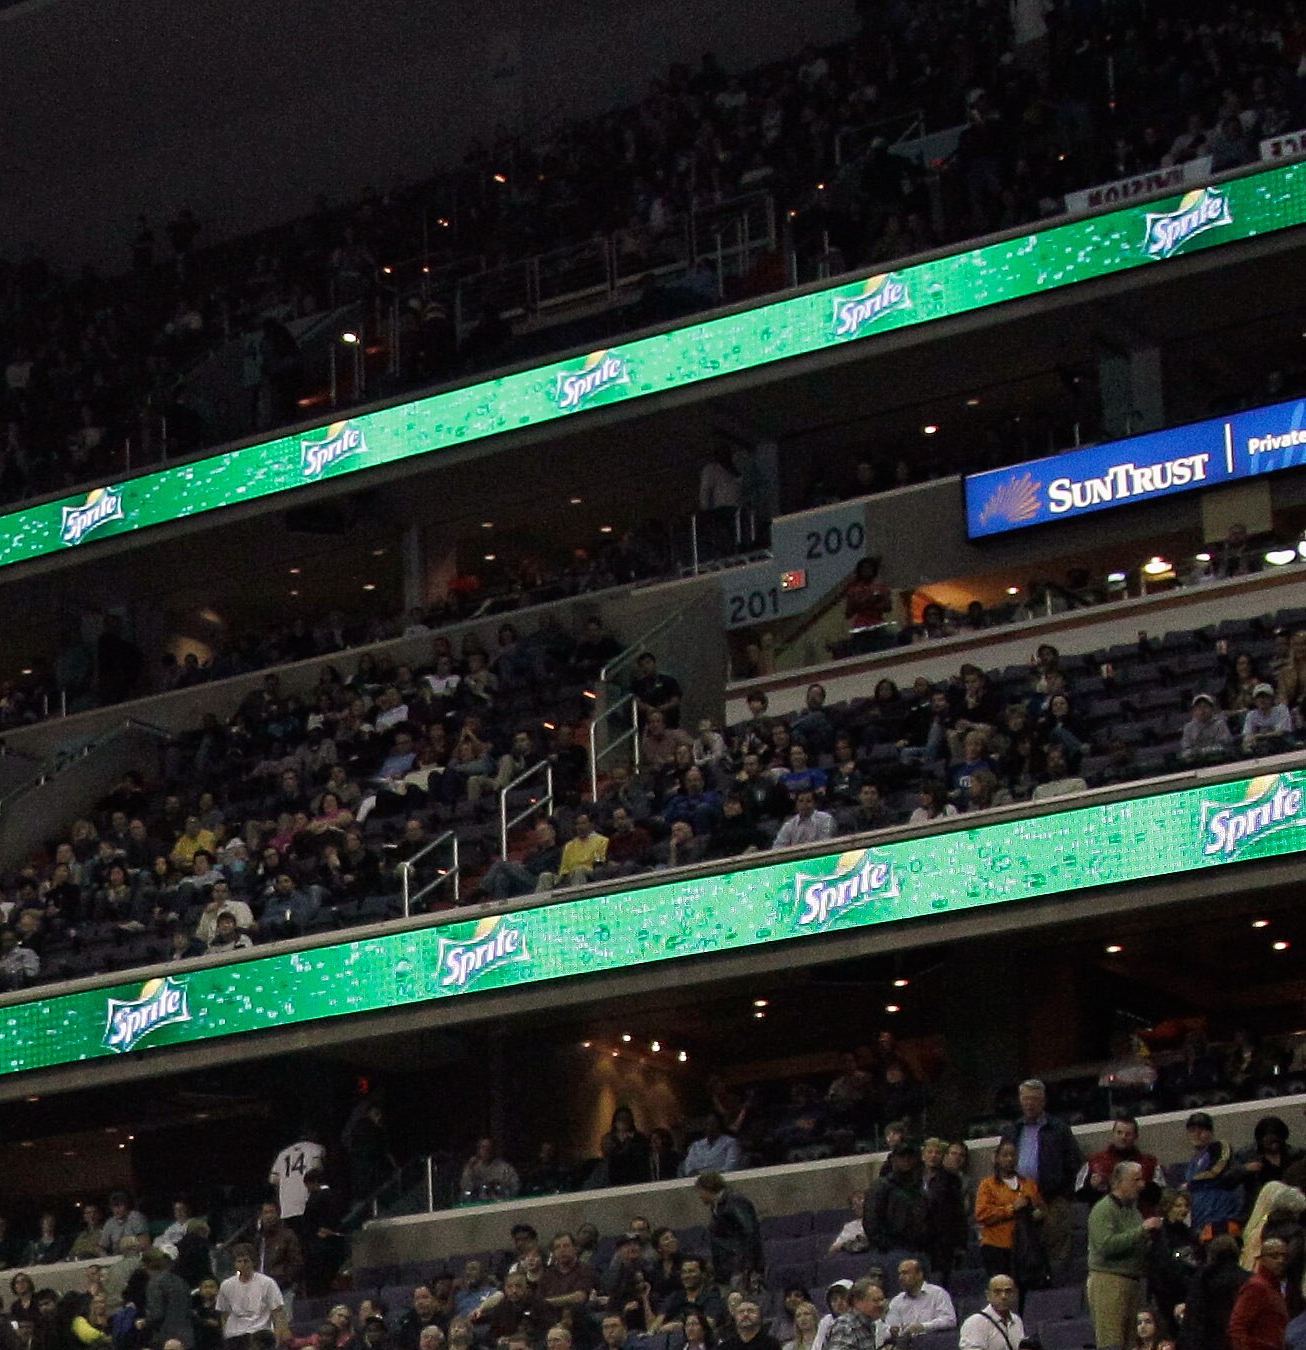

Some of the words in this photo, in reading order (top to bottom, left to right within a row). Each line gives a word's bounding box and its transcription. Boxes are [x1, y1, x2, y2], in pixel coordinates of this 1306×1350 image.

[1148, 195, 1222, 256] Sprite
[836, 282, 904, 336] Sprite
[559, 358, 621, 409] Sprite
[303, 428, 359, 476] Sprite
[64, 494, 117, 541] Sprite
[807, 522, 864, 559] 200
[730, 587, 778, 622] 201
[1205, 783, 1302, 855] Sprite
[799, 860, 887, 925] Sprite
[443, 926, 519, 986] Sprite
[108, 985, 180, 1044] Sprite
[284, 1152, 305, 1177] 14
